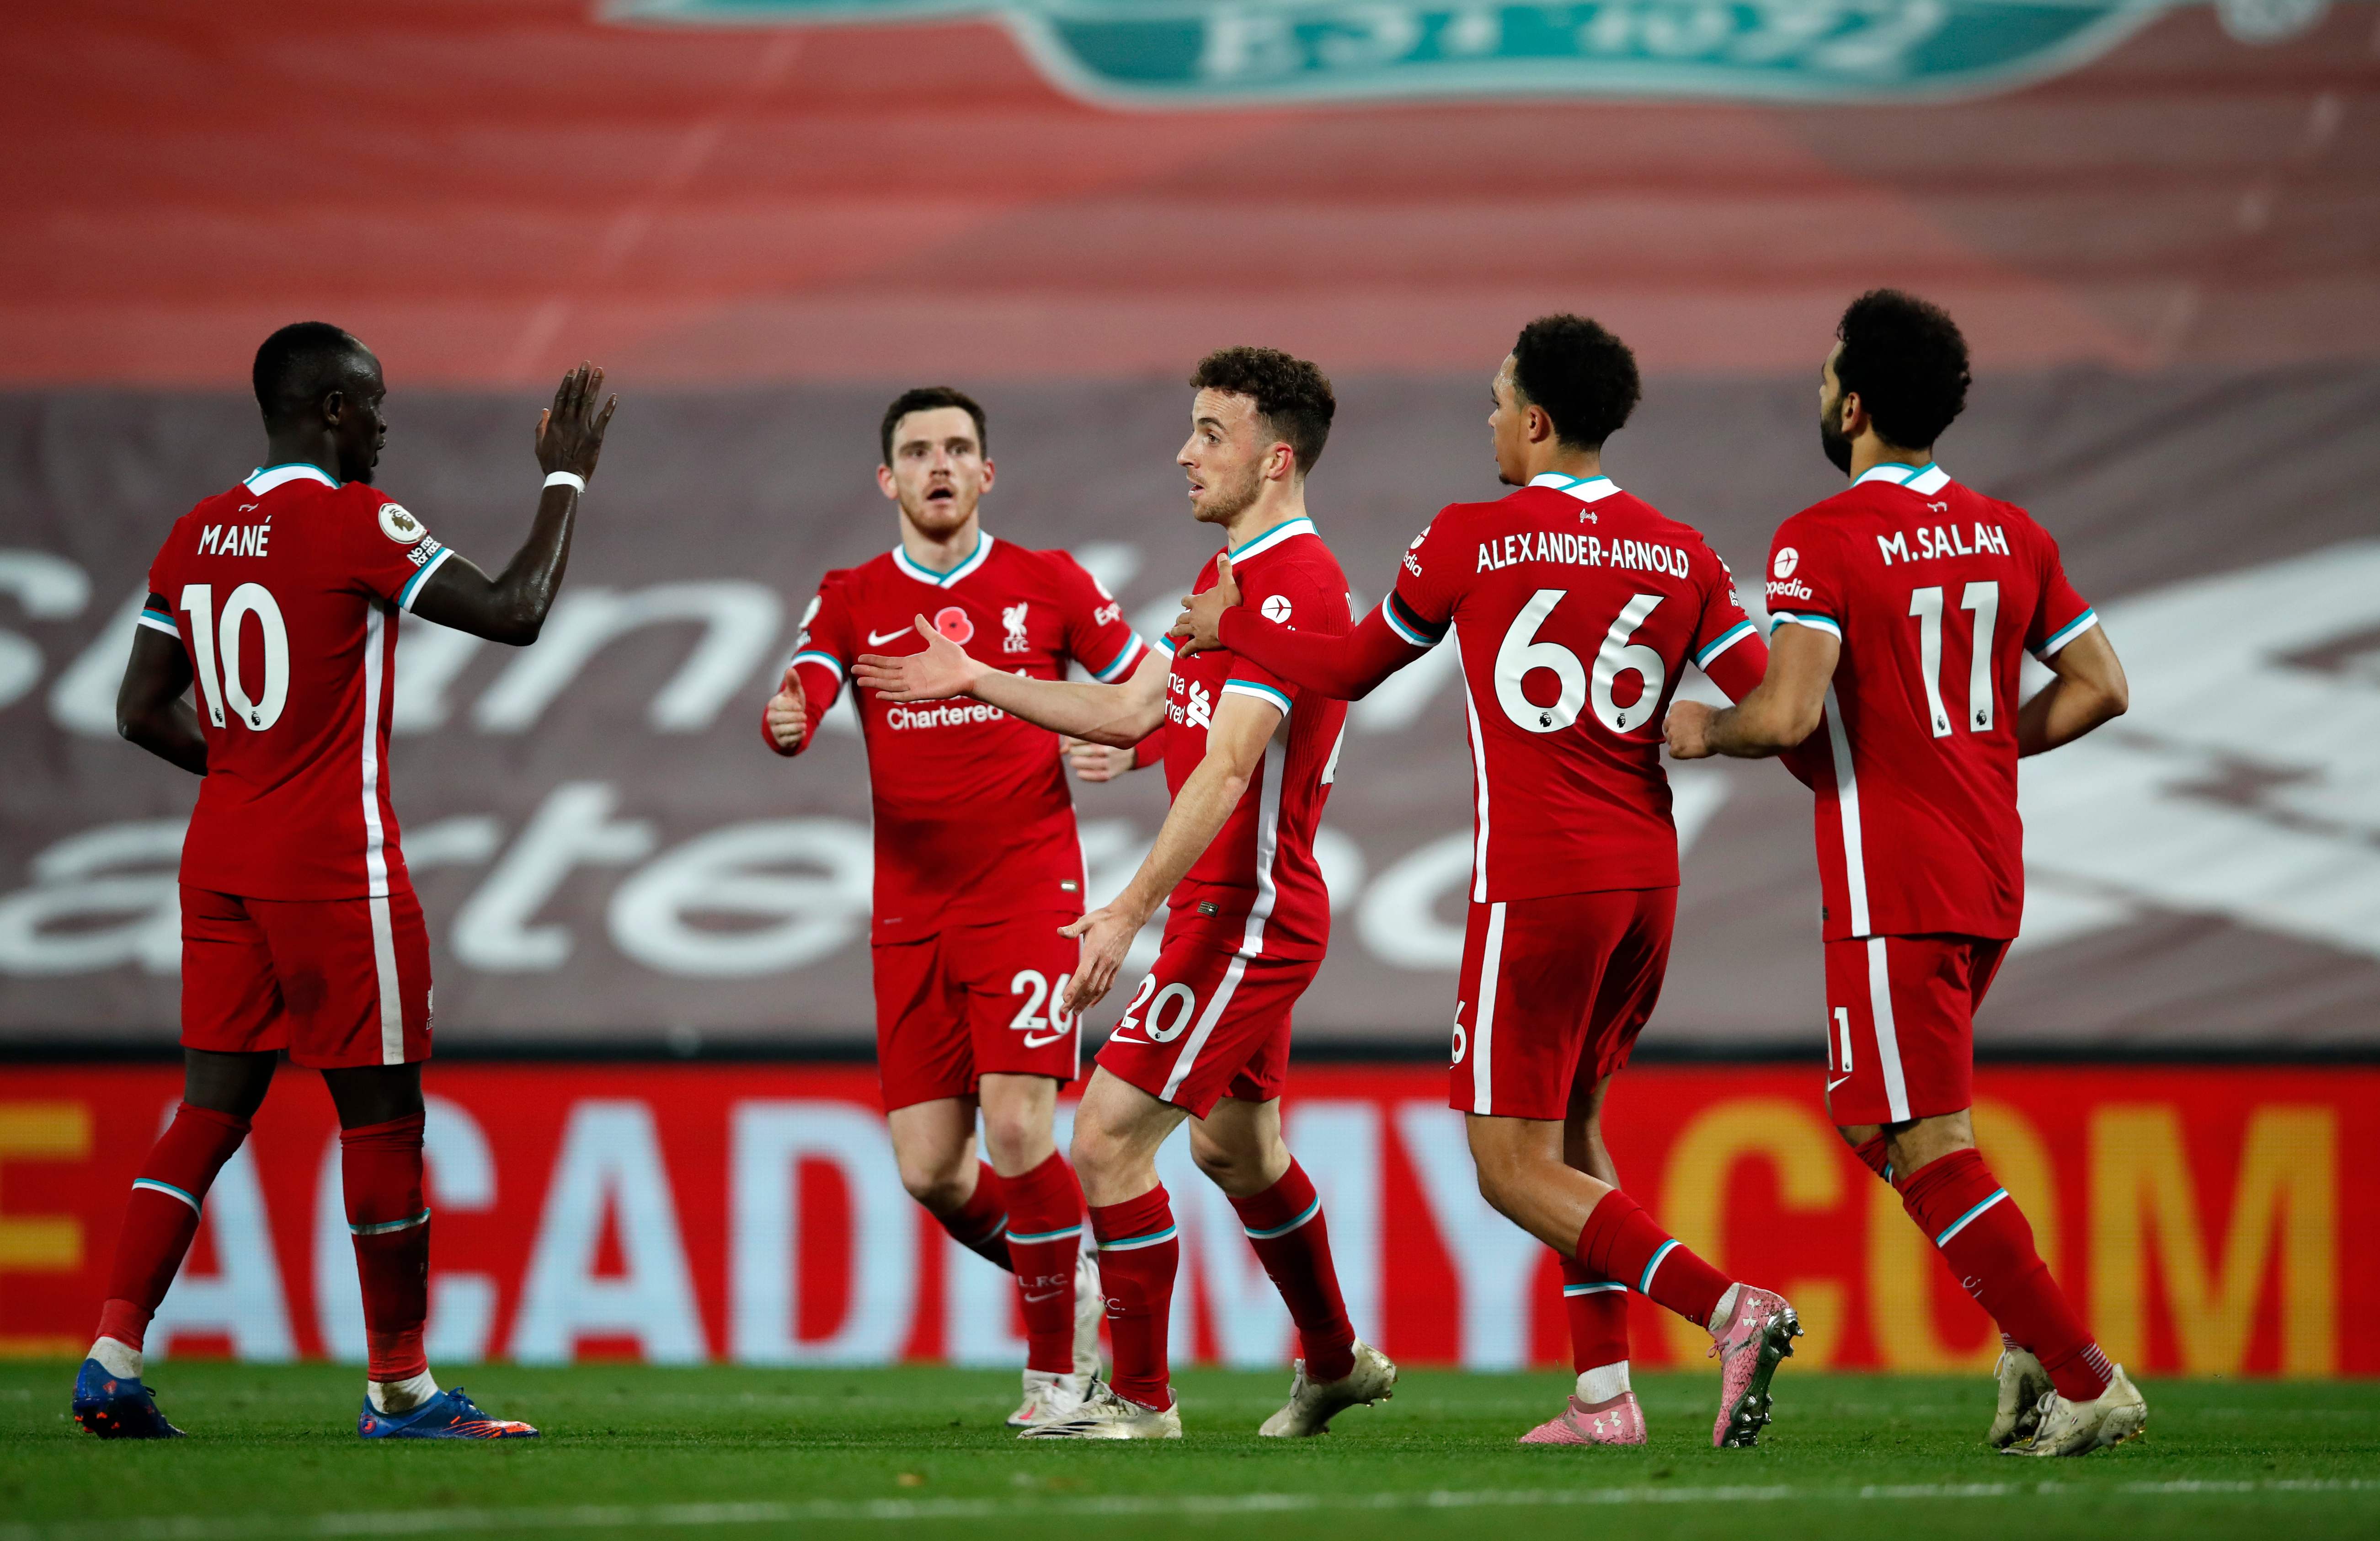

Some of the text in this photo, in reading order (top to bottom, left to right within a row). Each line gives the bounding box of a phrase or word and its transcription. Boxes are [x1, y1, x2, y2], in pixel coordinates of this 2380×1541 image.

[197, 515, 272, 557] MANÉ
[1477, 531, 1690, 580] ALEXANDER-ARNOLD
[1876, 521, 2011, 566] M.SALAH
[180, 582, 290, 732] 10
[1493, 588, 1666, 734] 66
[1908, 580, 2000, 738] 11
[886, 704, 1005, 731] Chartered
[1009, 969, 1074, 1035] 26
[1120, 973, 1196, 1043] 20
[1828, 1006, 1853, 1072] 1
